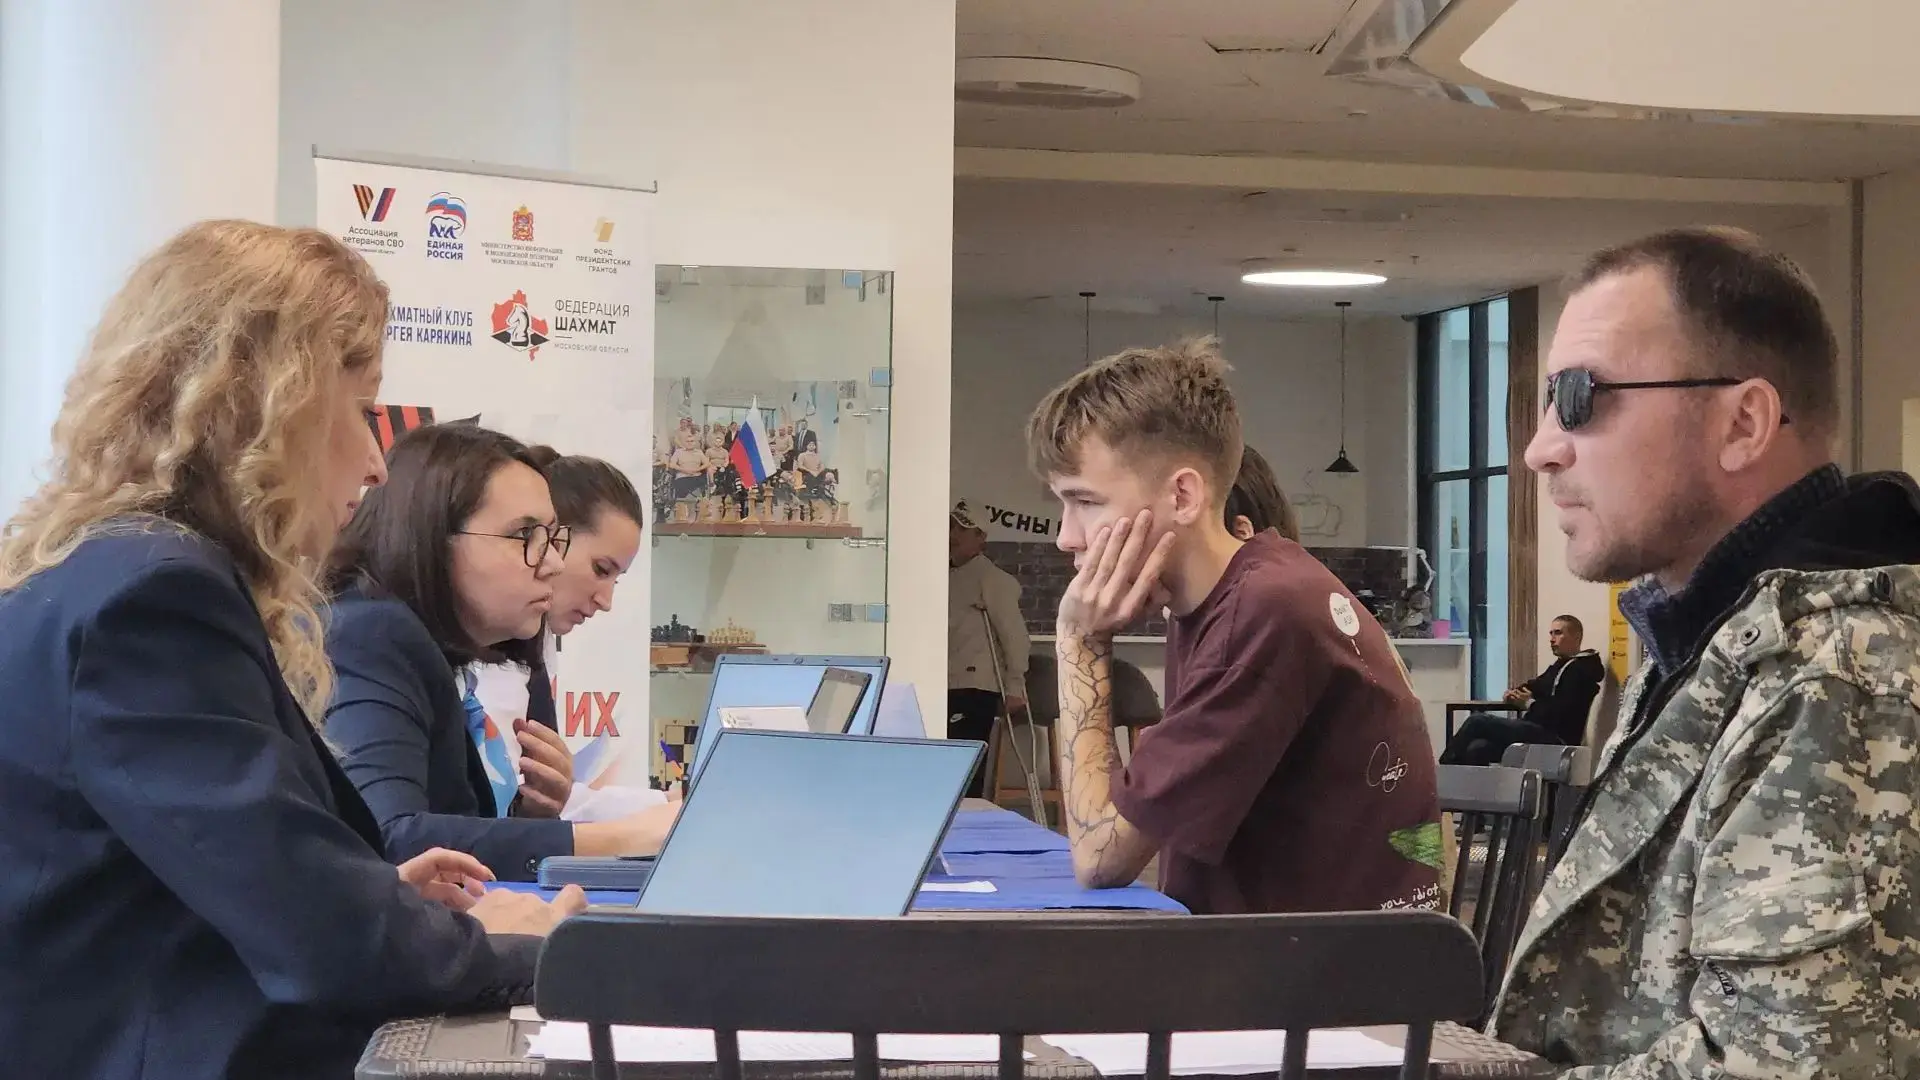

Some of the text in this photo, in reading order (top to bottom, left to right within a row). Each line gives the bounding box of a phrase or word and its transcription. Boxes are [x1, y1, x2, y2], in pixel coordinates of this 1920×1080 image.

[348, 226, 398, 238] Ассоциация
[343, 236, 404, 248] ветеранов СВО
[427, 240, 463, 250] ЕДИНАЯ
[427, 250, 463, 260] РОССИЯ
[593, 248, 613, 256] ФОНД
[576, 255, 631, 266] ПРЕЗИДЕНТСКИХ
[588, 265, 617, 274] ГРАНТОВ
[555, 299, 630, 317] ФЕДЕРАЦИЯ
[390, 306, 473, 326] ХМАТНЫЙ КЛУБ
[555, 316, 616, 335] ШАХМАТ
[386, 325, 472, 346] РГЕЯ КАРЯКИНА
[985, 505, 1051, 536] УСНЫ
[565, 691, 620, 737] ИХ
[1380, 897, 1406, 910] you
